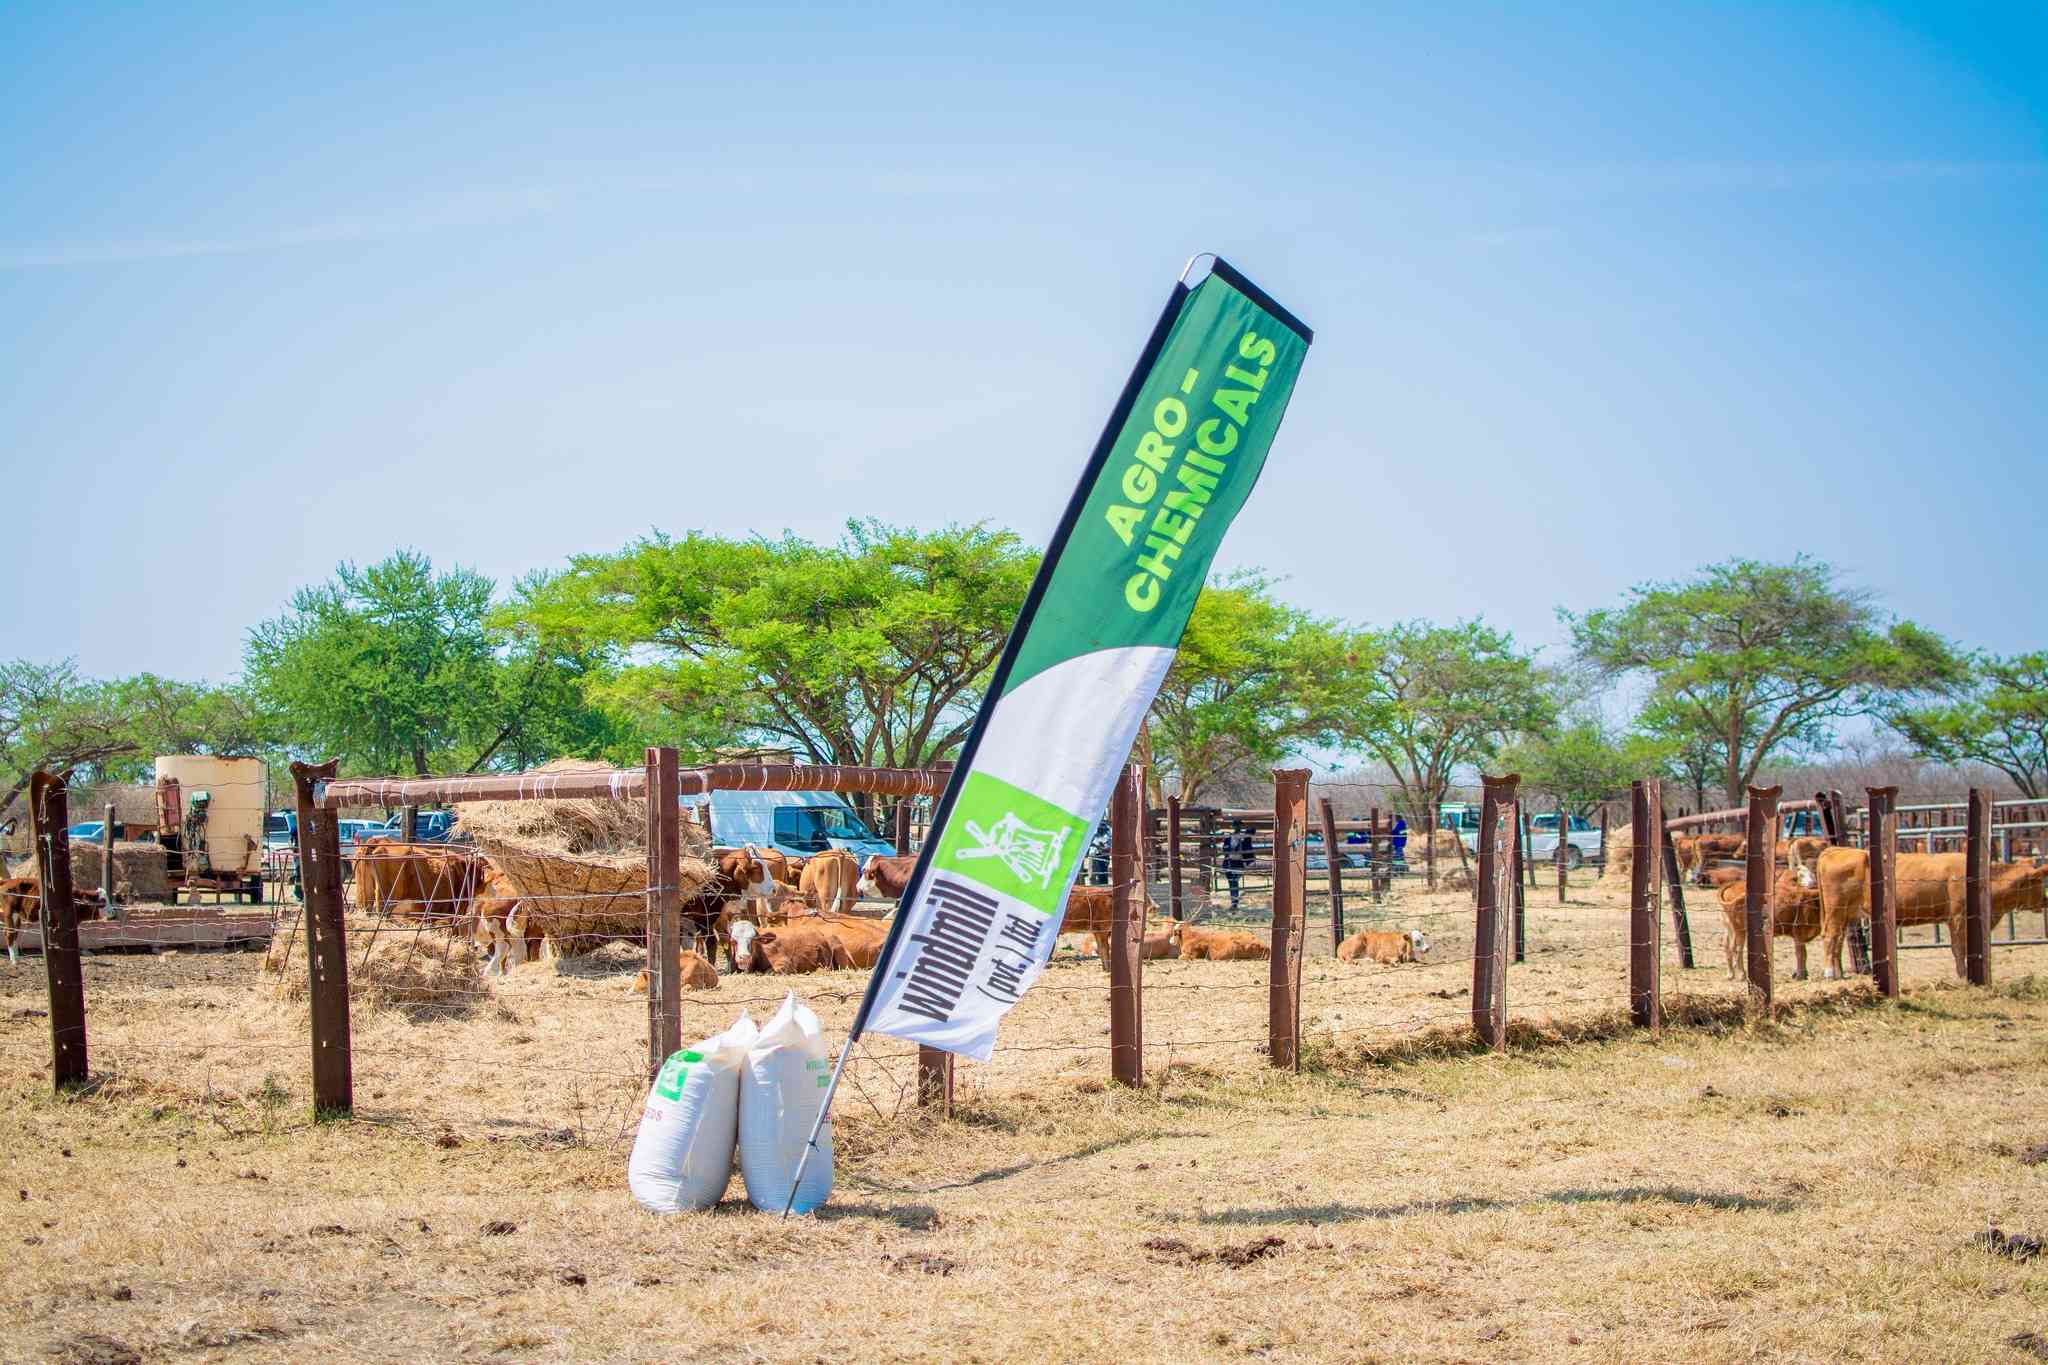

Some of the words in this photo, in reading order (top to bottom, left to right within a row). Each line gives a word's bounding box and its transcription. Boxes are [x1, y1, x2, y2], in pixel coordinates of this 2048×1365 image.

[1104, 367, 1199, 547] AGRO-
[1124, 331, 1276, 612] CHEMICALS
[896, 879, 999, 1022] windmill
[1000, 913, 1043, 949] ltd.
